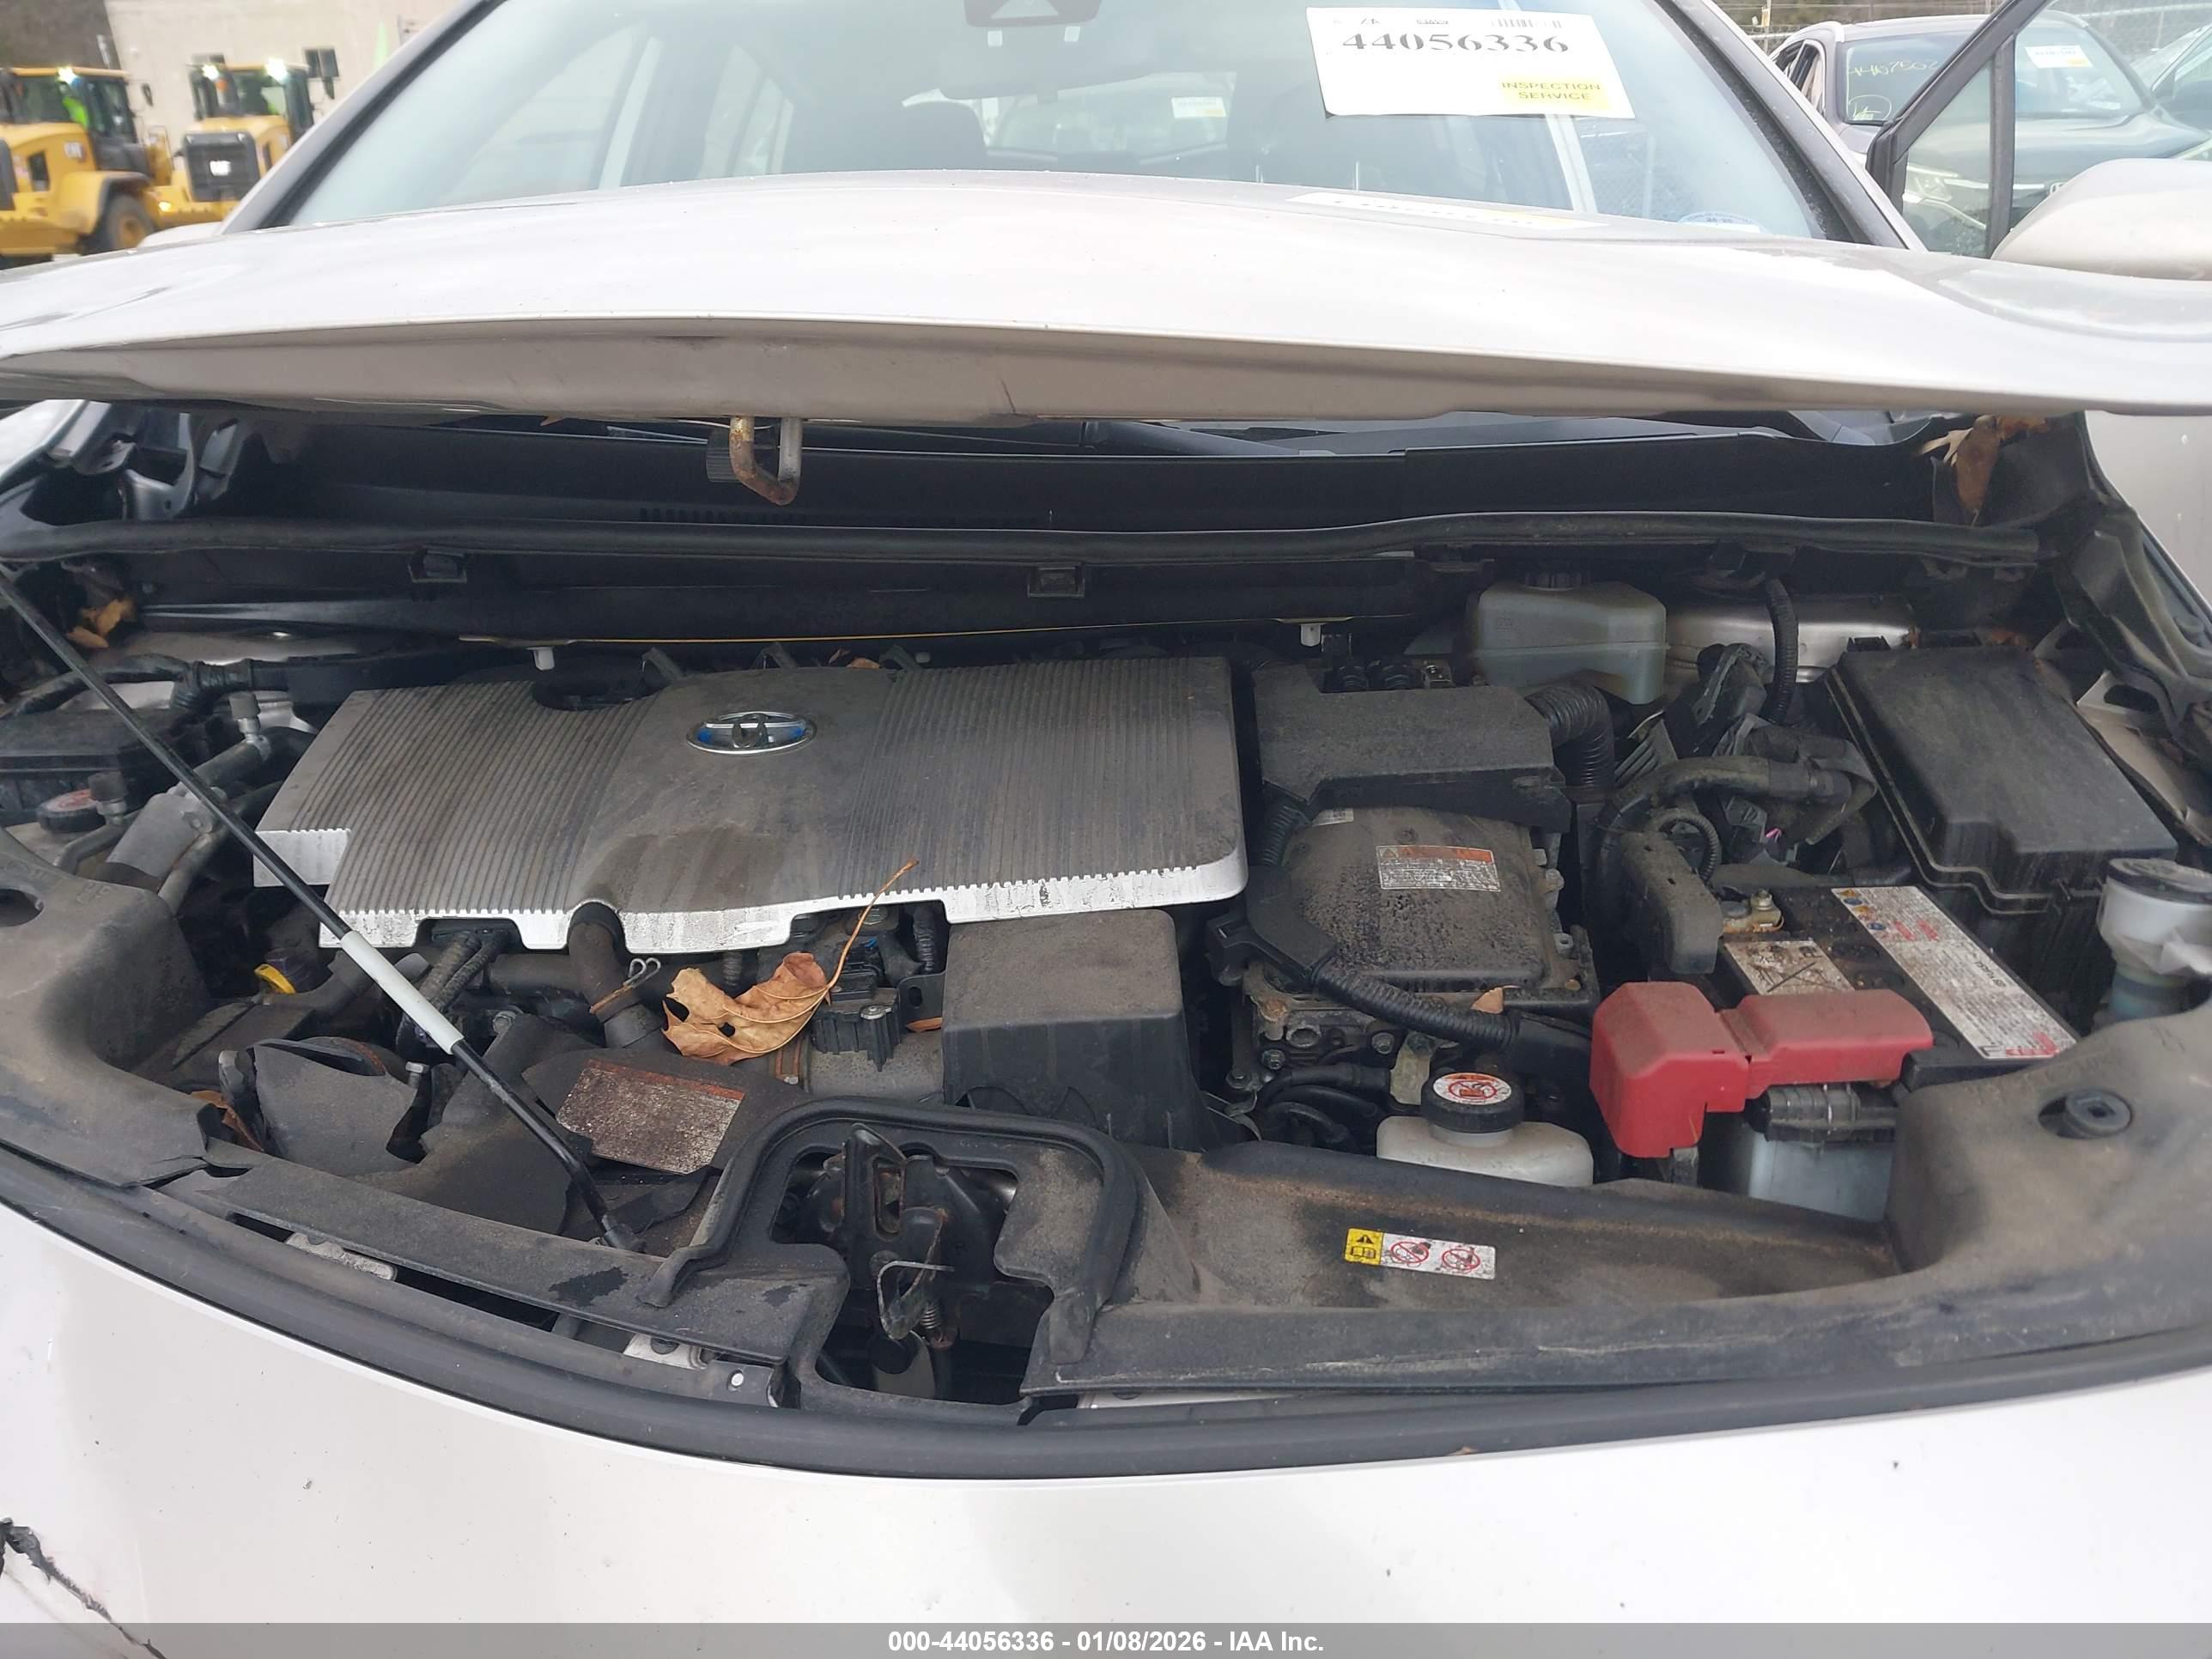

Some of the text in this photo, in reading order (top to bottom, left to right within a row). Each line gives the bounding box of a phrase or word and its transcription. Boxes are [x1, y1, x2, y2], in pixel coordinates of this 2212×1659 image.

[1342, 33, 1569, 52] 44056336
[1501, 82, 1601, 90] INSPECTION
[1517, 92, 1591, 100] SERVICE
